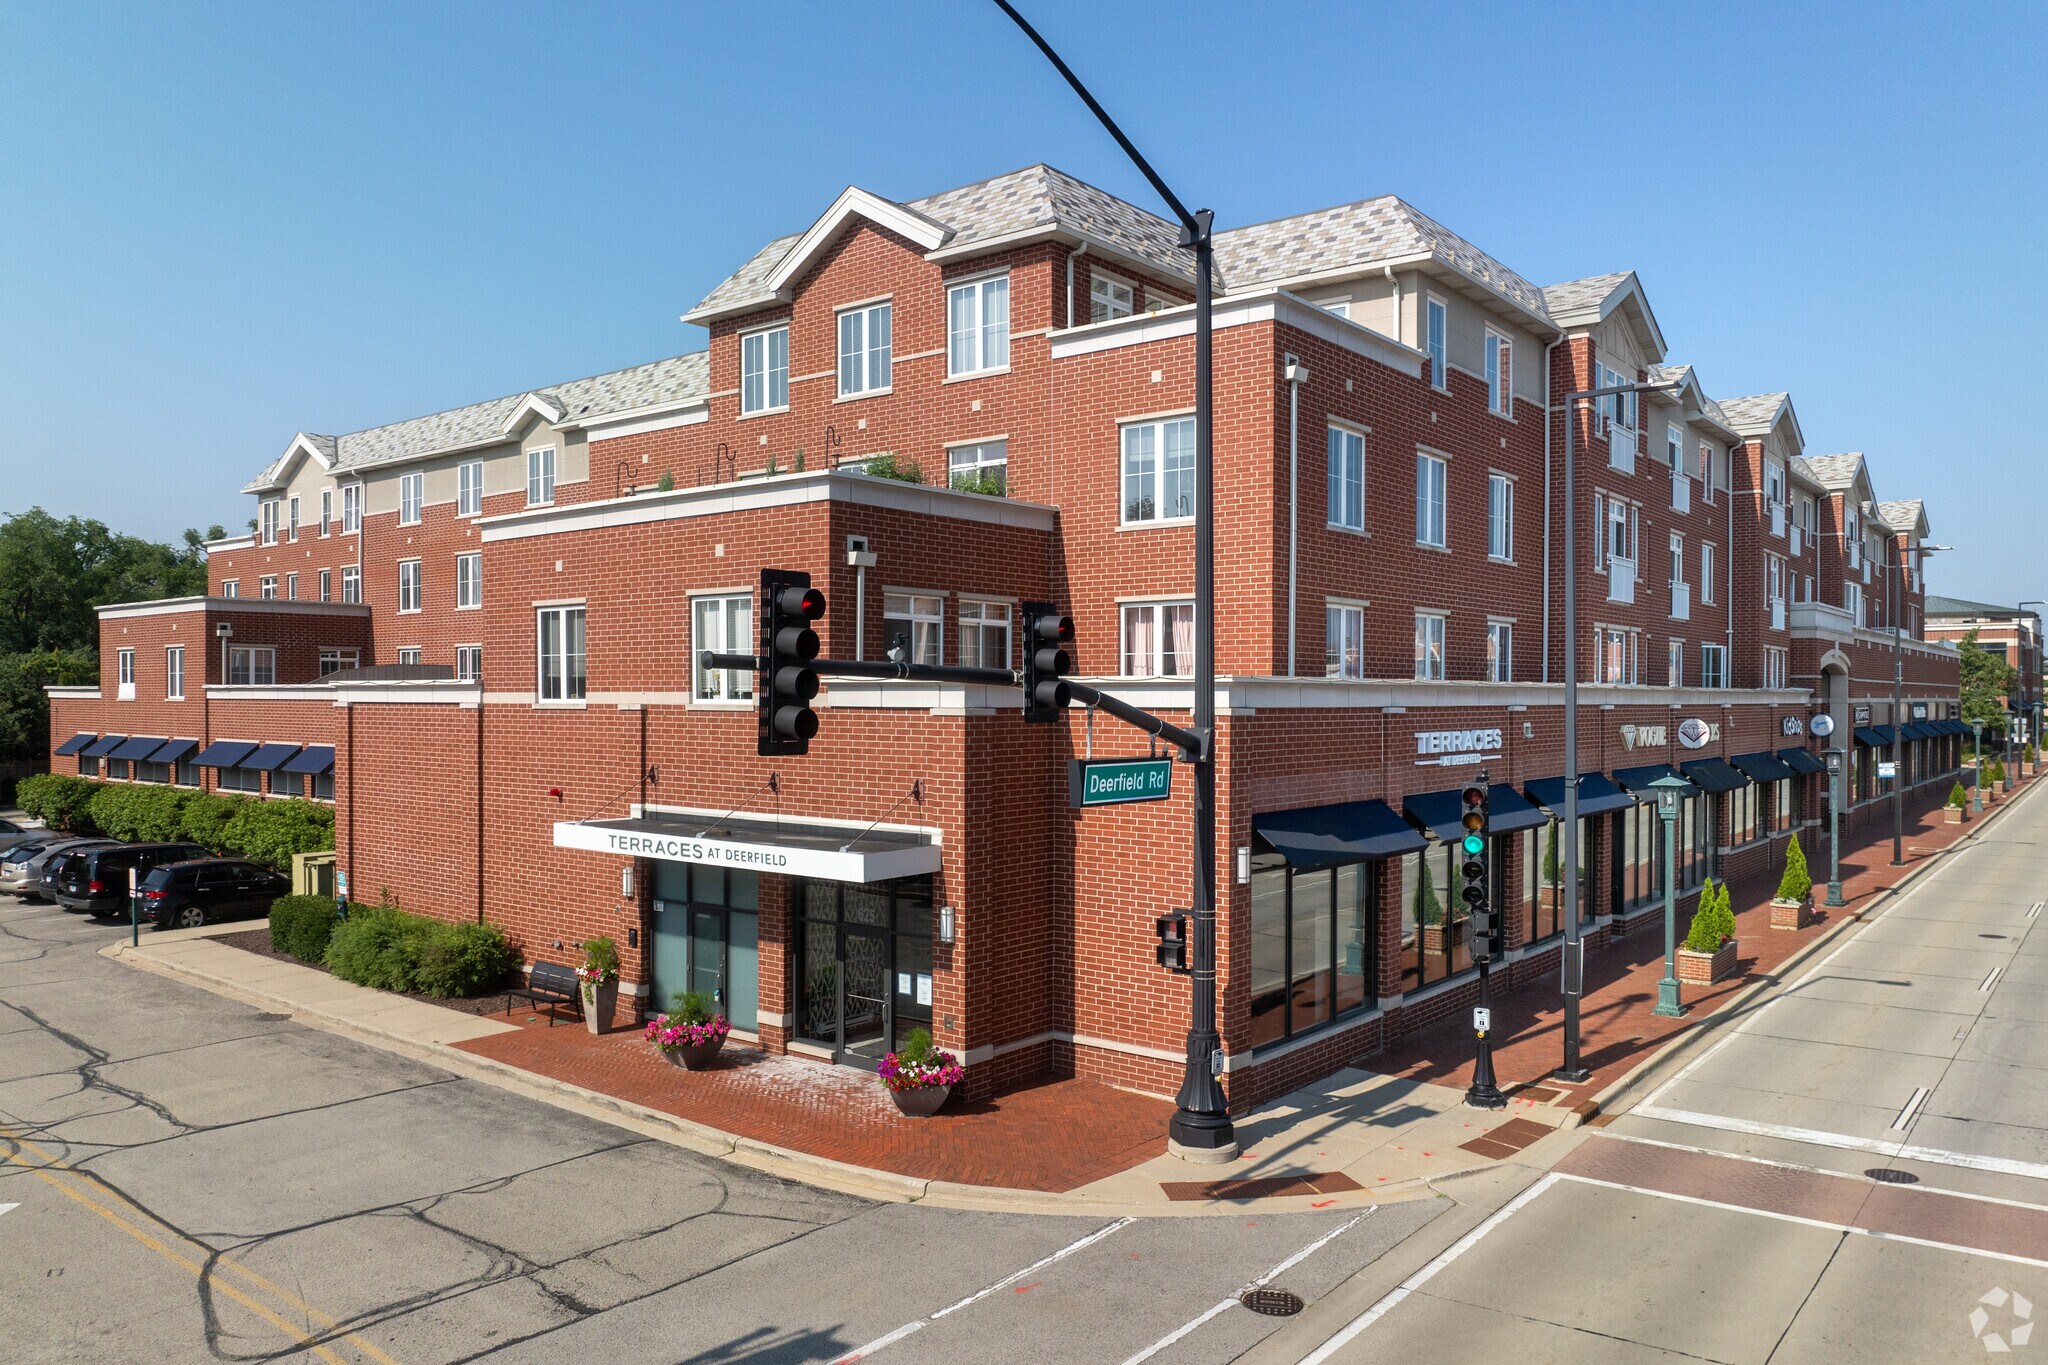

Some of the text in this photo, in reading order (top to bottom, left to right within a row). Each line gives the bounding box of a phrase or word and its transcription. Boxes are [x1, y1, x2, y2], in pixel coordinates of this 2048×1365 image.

[1415, 728, 1502, 754] TERRACES
[1637, 725, 1667, 747] VOGUE
[1090, 771, 1164, 793] Deerfield Rd
[608, 834, 787, 866] TERRACES AT DEERFIELD
[858, 908, 875, 923] 625
